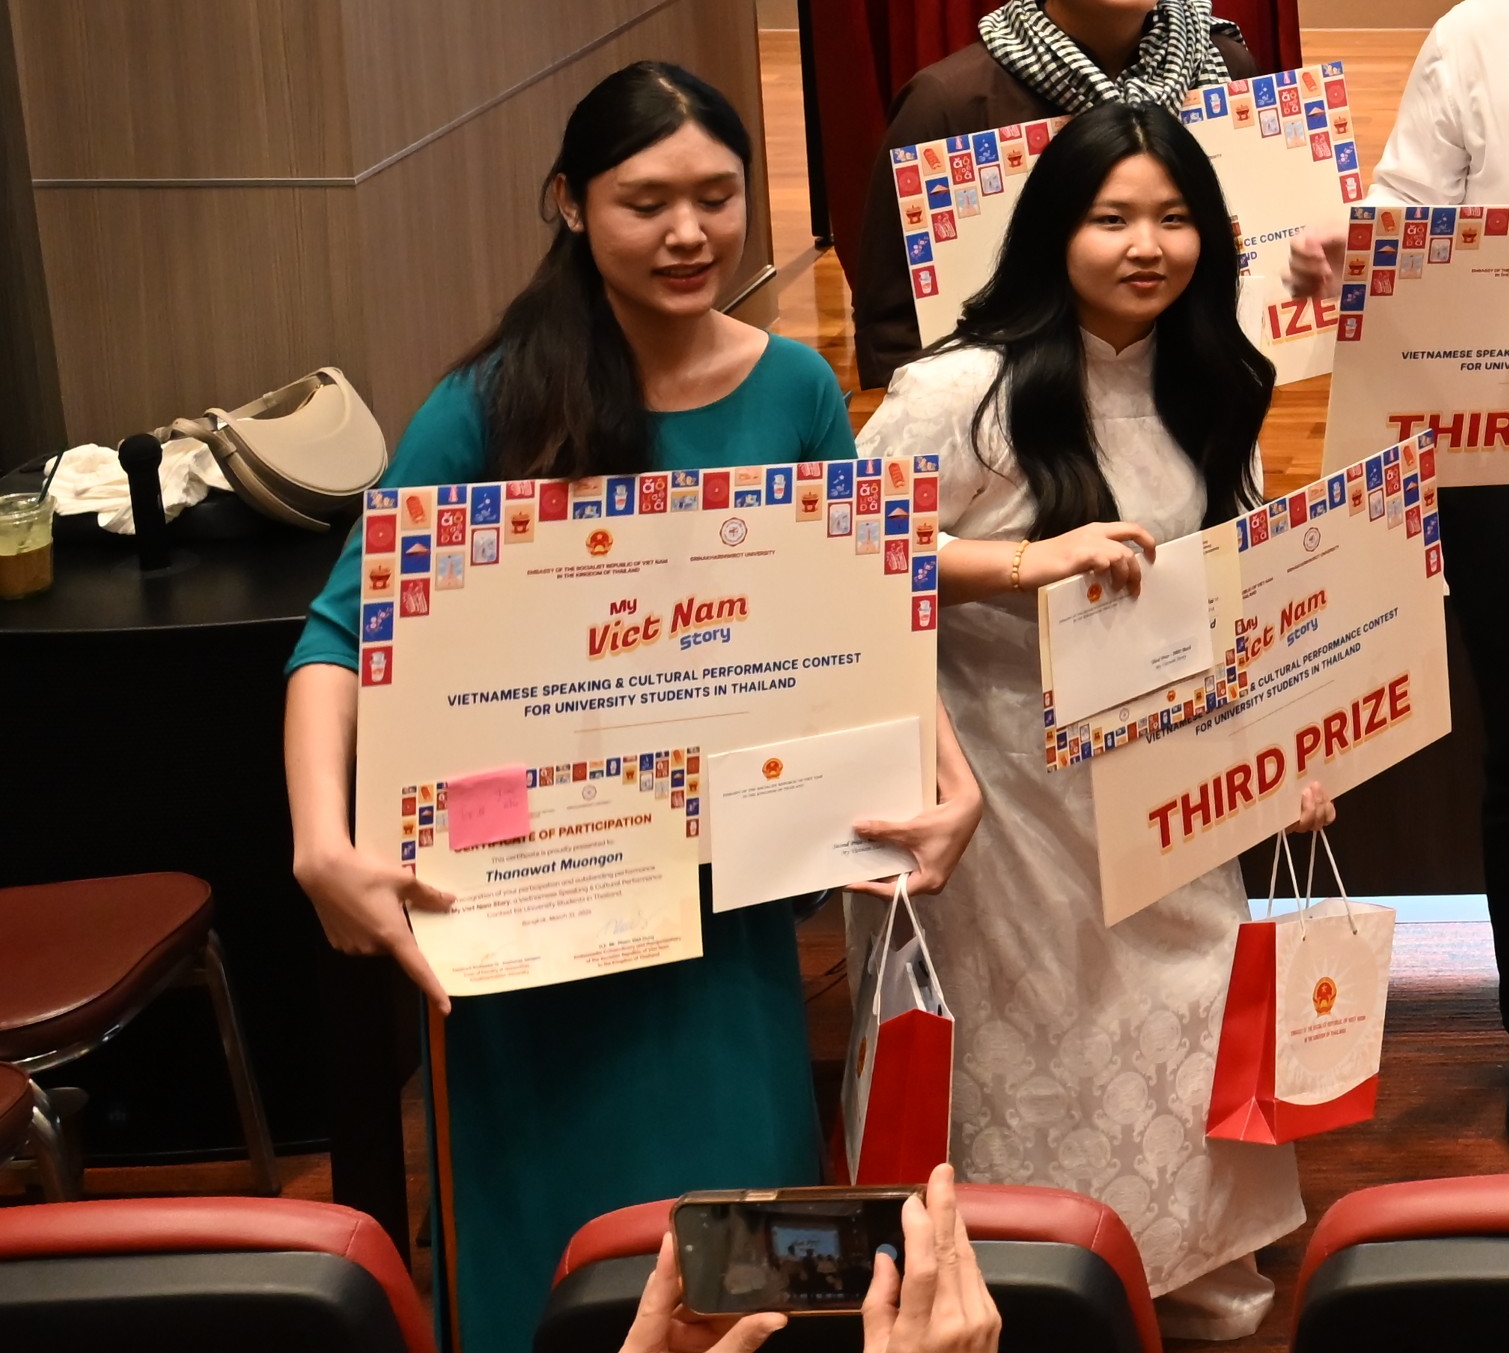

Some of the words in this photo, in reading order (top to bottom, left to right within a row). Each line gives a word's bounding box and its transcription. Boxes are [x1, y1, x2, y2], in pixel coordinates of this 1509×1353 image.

[1267, 298, 1339, 339] IZE
[1401, 349, 1472, 359] VIETNAMESE
[1460, 362, 1481, 370] FOR
[588, 615, 661, 656] Viet
[670, 597, 748, 634] Nam
[610, 598, 637, 615] My
[1281, 588, 1327, 635] Nam
[1250, 682, 1256, 691] &
[1257, 659, 1301, 687] CULTURAL
[1302, 626, 1361, 664] PERFORMANCE
[1362, 607, 1397, 632] CONTEST
[447, 686, 537, 706] VIETNAMESE
[542, 678, 611, 696] SPEAKING
[615, 677, 624, 688] &
[628, 669, 698, 687] CULTURAL
[702, 658, 798, 679] PERFORMANCE
[802, 652, 861, 668] CONTEST
[524, 703, 551, 717] FOR
[555, 694, 636, 713] UNIVERSITY
[640, 686, 710, 704] STUDENTS
[714, 684, 726, 696] IN
[731, 677, 796, 693] THAILAND
[1195, 716, 1212, 734] FOR
[1214, 692, 1264, 725] UNIVERSITY
[1266, 669, 1309, 698] STUDENTS
[1311, 663, 1319, 675] IN
[1321, 642, 1360, 669] THAILAND
[1149, 746, 1286, 849] THIRD
[1296, 673, 1412, 773] PRIZE
[538, 828, 555, 839] OF
[558, 813, 651, 837] PARTICIPATION
[486, 861, 556, 882] Thanawat
[560, 852, 623, 870] Muongon
